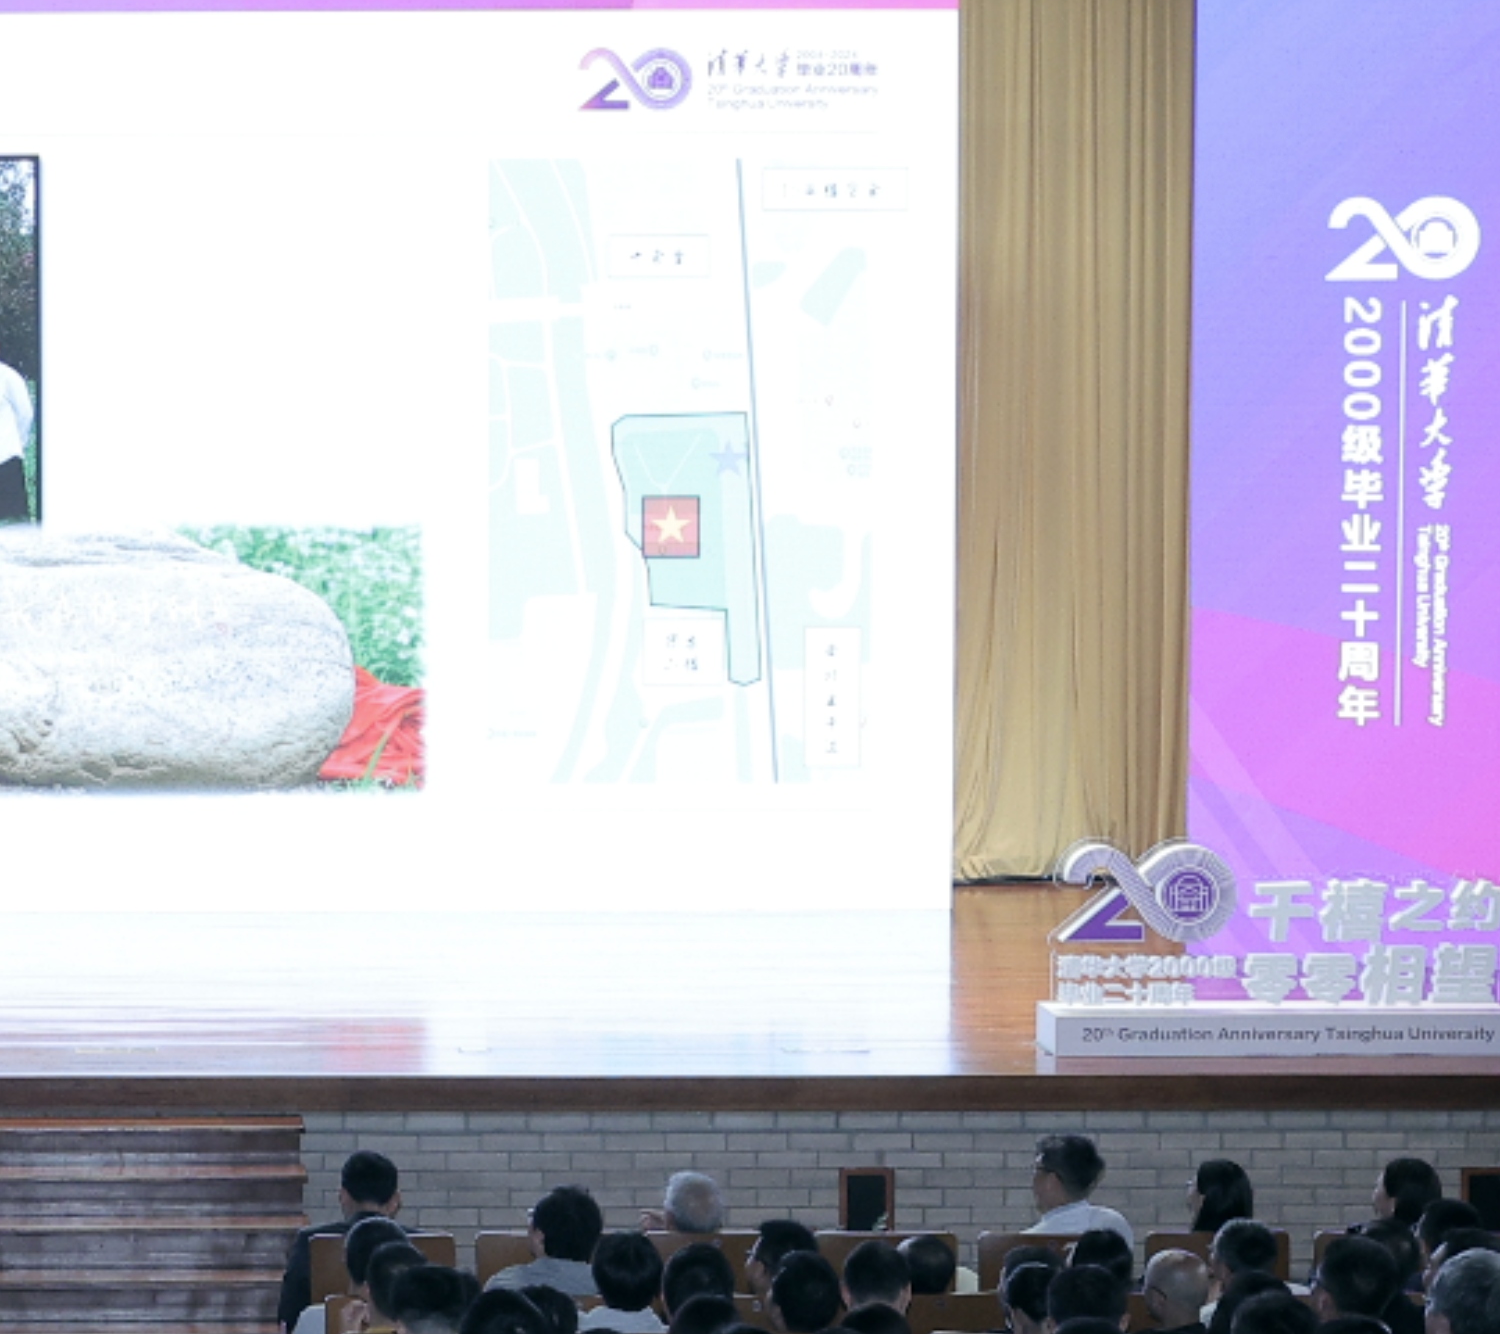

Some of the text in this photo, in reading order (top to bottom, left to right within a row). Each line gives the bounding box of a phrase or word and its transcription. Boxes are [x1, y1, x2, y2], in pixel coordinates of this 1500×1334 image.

[1417, 295, 1459, 509] 清华大学
[1338, 296, 1384, 726] 2000级毕业二十周年
[1117, 1027, 1213, 1042] Graduation
[1217, 1027, 1321, 1044] Anniversary
[1325, 1027, 1404, 1044] Tsinghua
[1408, 1026, 1496, 1044] University
[1240, 943, 1499, 1006] 零零相望
